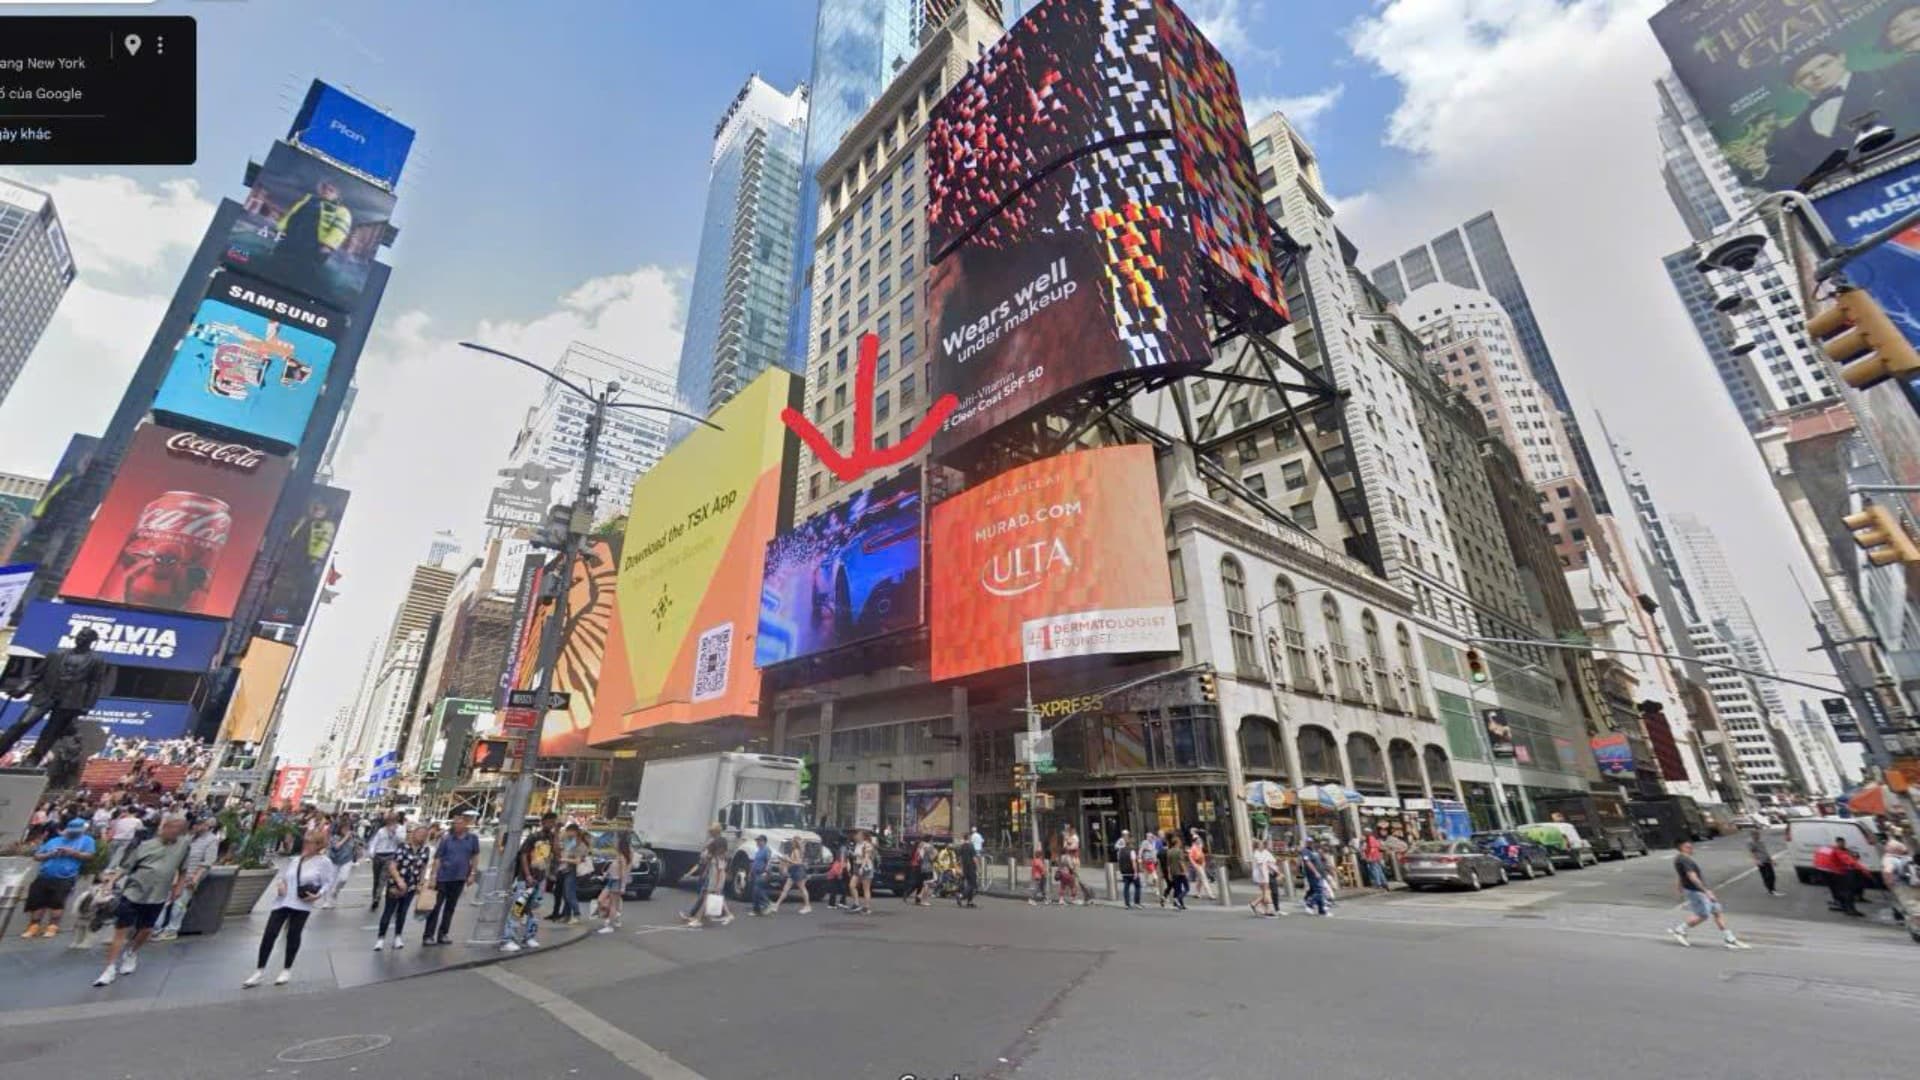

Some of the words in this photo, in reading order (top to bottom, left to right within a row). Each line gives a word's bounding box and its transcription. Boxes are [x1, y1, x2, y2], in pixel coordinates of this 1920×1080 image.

[228, 285, 328, 328] SAMSUNG
[943, 300, 1010, 356] Wears
[1014, 256, 1068, 307] well
[957, 325, 1002, 363] under
[1004, 280, 1078, 333] makeup
[951, 407, 977, 427] Clear
[977, 391, 1002, 411] Coat
[1003, 375, 1025, 397] SPF
[1027, 365, 1044, 383] 50
[957, 372, 1016, 411] ulti-Vitamin
[624, 530, 667, 572] Download
[668, 522, 685, 543] the
[688, 502, 711, 530] TSX
[711, 489, 737, 515] App
[975, 500, 1082, 544] MURAD.COM
[990, 537, 1074, 584] ULTA
[67, 619, 177, 647] TRIVIA
[1053, 616, 1167, 634] DERMATOLOGIST
[57, 635, 175, 659] MMENTS
[1031, 693, 1105, 719] EXPRESS
